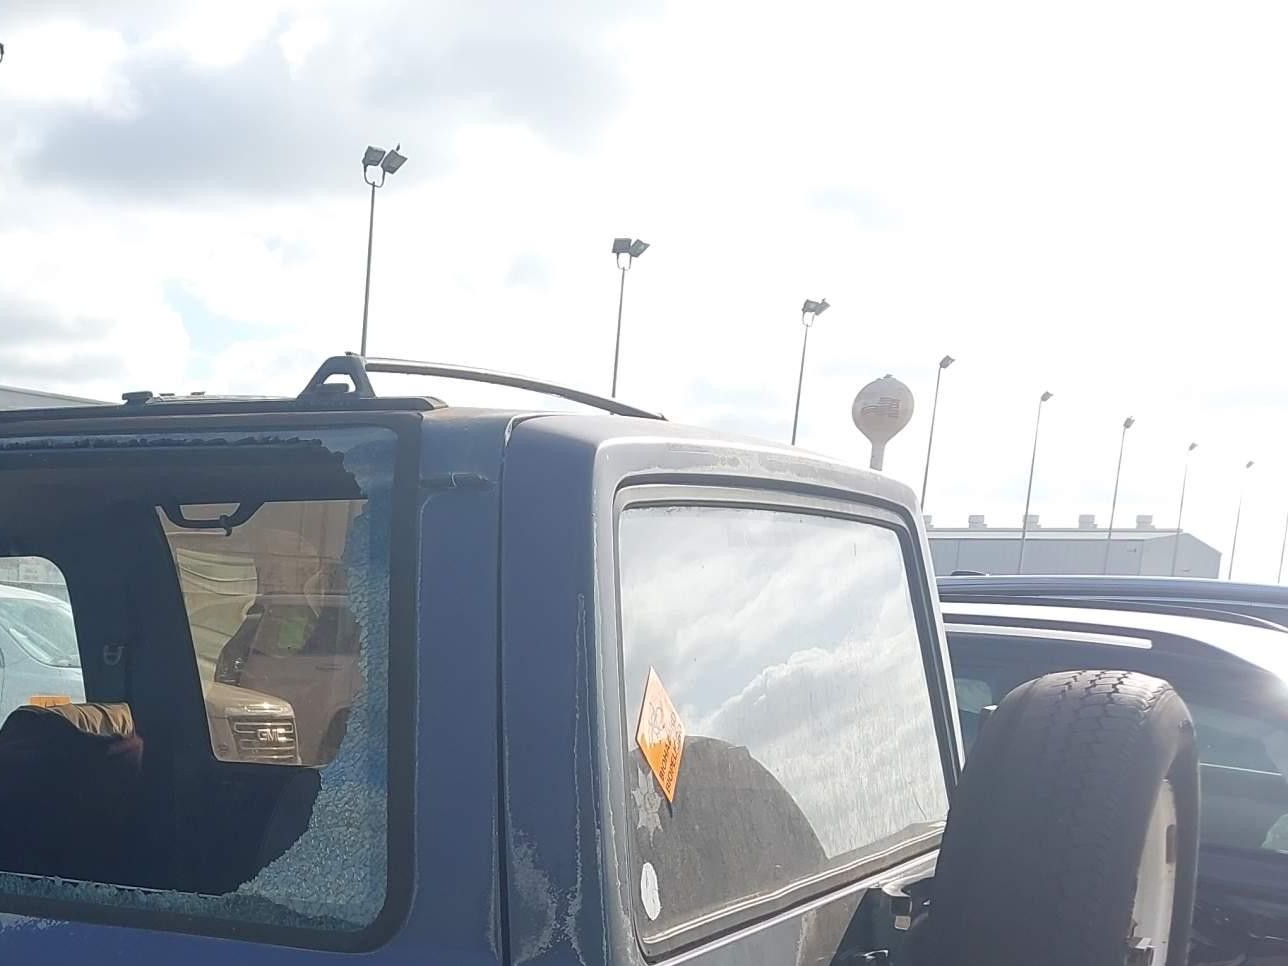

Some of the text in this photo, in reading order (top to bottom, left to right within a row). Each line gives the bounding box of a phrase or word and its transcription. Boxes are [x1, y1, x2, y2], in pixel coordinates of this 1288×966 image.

[257, 728, 287, 741] GMC
[658, 711, 677, 782] BIOHARD
[665, 722, 683, 794] BIOPELI
